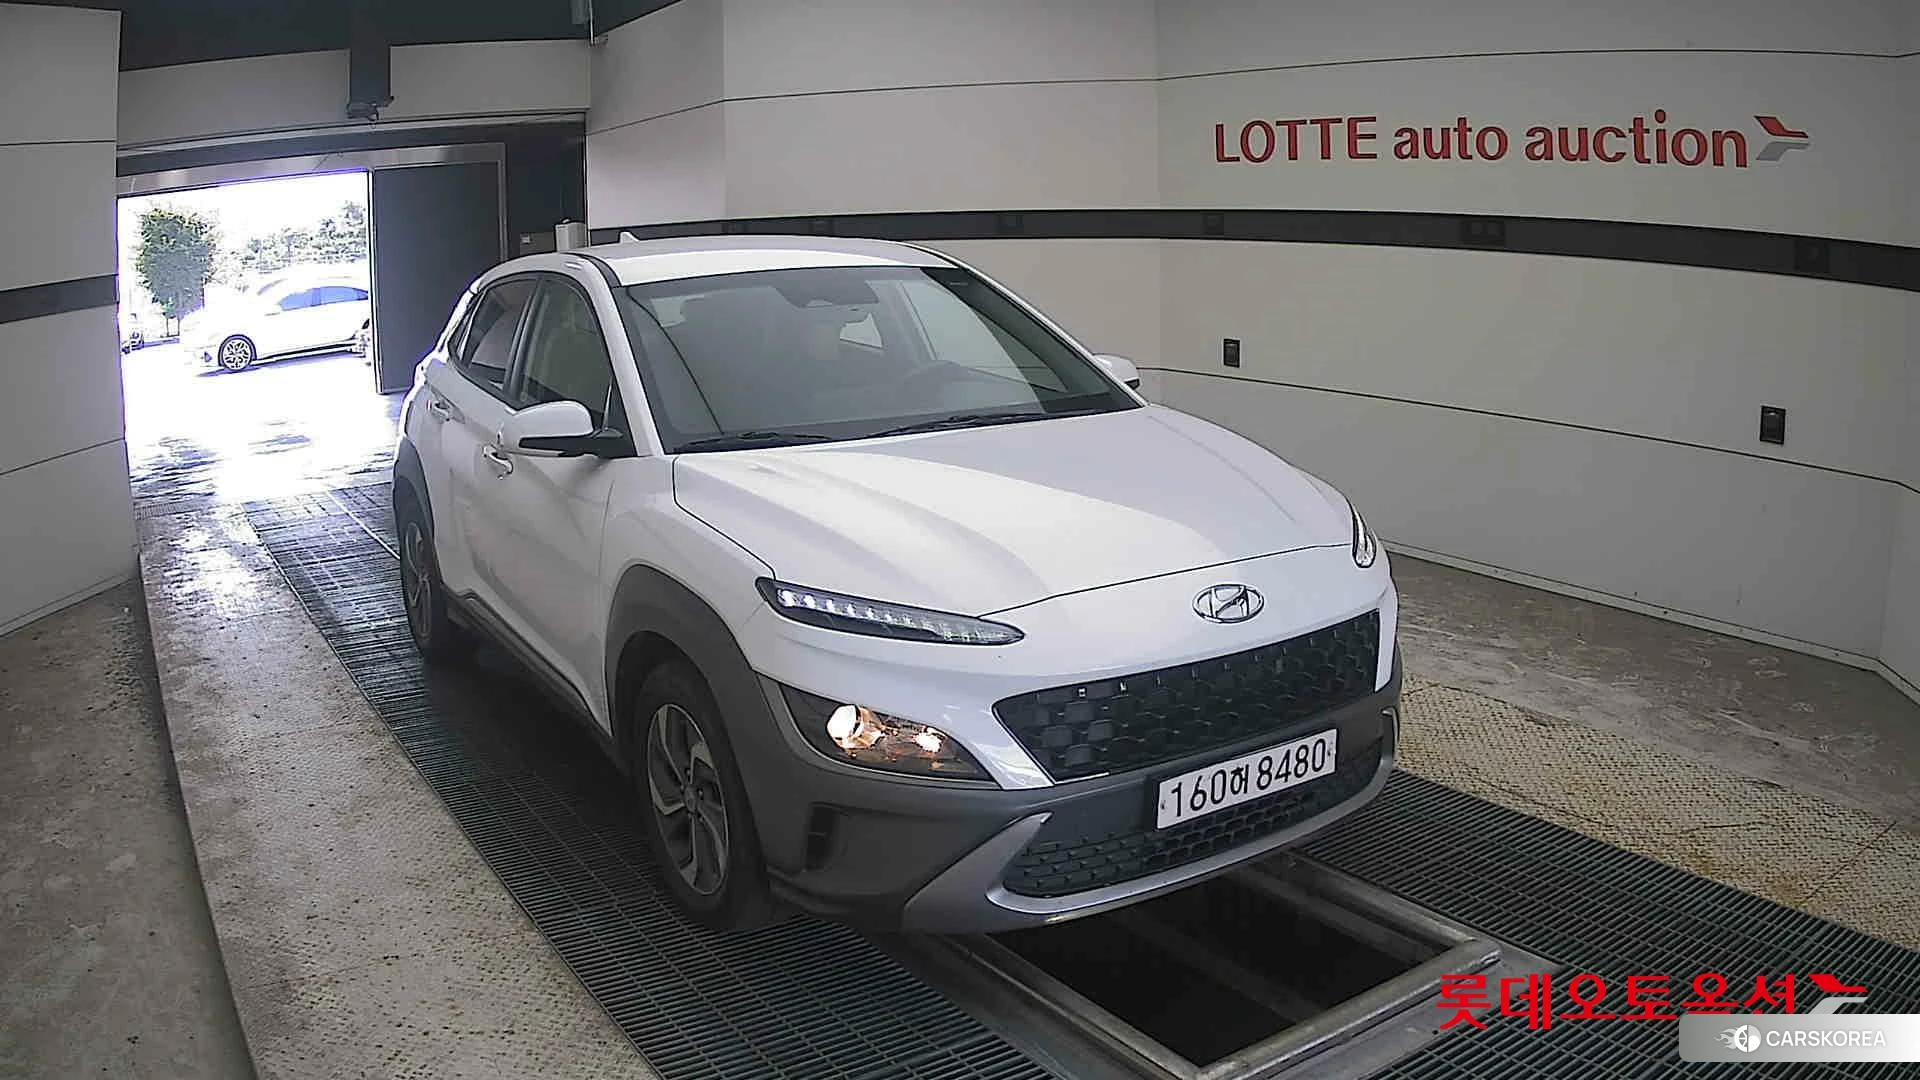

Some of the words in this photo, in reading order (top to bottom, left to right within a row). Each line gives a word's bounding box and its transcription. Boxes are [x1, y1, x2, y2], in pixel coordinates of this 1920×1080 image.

[1215, 117, 1377, 163] LOTTE
[1393, 117, 1508, 161] auto
[1524, 109, 1748, 168] auction
